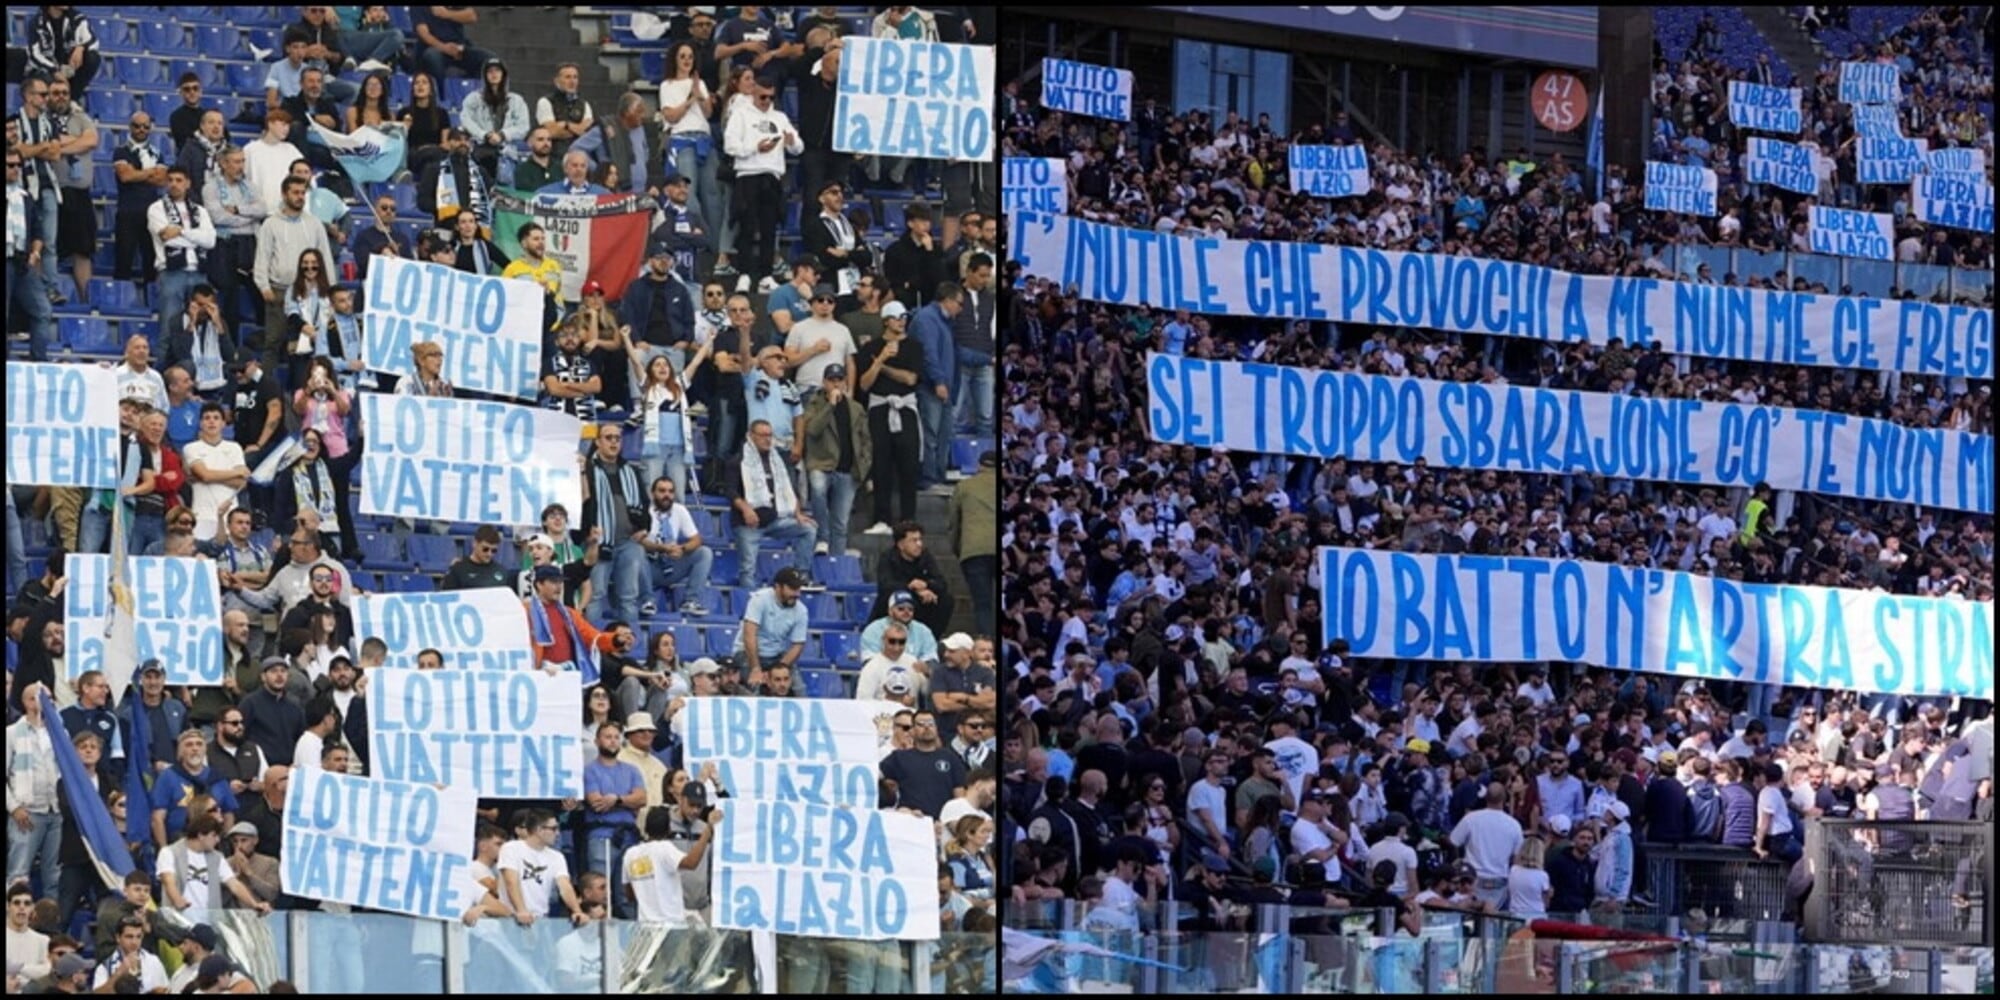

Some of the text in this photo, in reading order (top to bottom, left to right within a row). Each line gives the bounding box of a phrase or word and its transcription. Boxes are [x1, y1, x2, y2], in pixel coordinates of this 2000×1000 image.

[839, 39, 980, 101] LIBERA
[1046, 58, 1118, 92] LOTITO
[1544, 75, 1574, 98] 47
[1046, 85, 1127, 120] VATTENE
[1541, 99, 1574, 125] AS
[1734, 82, 1792, 109] LIBERA
[879, 97, 989, 158] LAZIO
[1731, 104, 1799, 131] LA LAZIO
[1291, 145, 1342, 170] LIBERA
[1757, 139, 1811, 172] LIBERA
[1863, 139, 1920, 160] LIBERA
[1004, 159, 1049, 185] ITO
[1648, 163, 1703, 189] LOTITO
[1752, 161, 1815, 193] LA LAZIO
[1861, 160, 1879, 181] LA
[1647, 186, 1714, 216] VATTENE
[1922, 176, 1977, 205] LIBERA
[544, 216, 580, 235] LAZIO
[1816, 207, 1879, 235] LIBERA
[1927, 200, 1993, 230] LAZIO
[1813, 229, 1888, 259] LA LAZIO
[370, 258, 506, 334] LOTITO
[1062, 217, 1227, 314] INUTILE
[1245, 241, 1327, 319] CHE
[1341, 247, 1551, 336] PROVOCHI
[1562, 273, 1590, 342] A
[1607, 277, 1658, 350] ME
[1675, 282, 1753, 356] NUN
[1765, 291, 1816, 363] ME
[1833, 299, 1881, 367] CE
[1894, 307, 1989, 377] FREG
[368, 395, 534, 463] LOTITO
[1151, 354, 1224, 444] SEI
[1241, 364, 1425, 462] TROPPO
[1438, 381, 1703, 481] SBARAJONE
[1715, 405, 1781, 486] CO'
[1797, 410, 1847, 493] TE
[1856, 420, 1944, 506] NUN
[68, 556, 217, 620] LIERA
[1323, 549, 1379, 655] IO
[1392, 552, 1588, 661] BATTO
[1605, 565, 1853, 690] N'ARTRA
[374, 669, 538, 731] LOTITO
[688, 699, 838, 761] LIBERA
[375, 732, 578, 797] VATTENE
[288, 767, 439, 845] LOTITO
[721, 802, 894, 874] LIBERA
[287, 829, 467, 917] VATTENE
[775, 868, 907, 936] LAZIO
